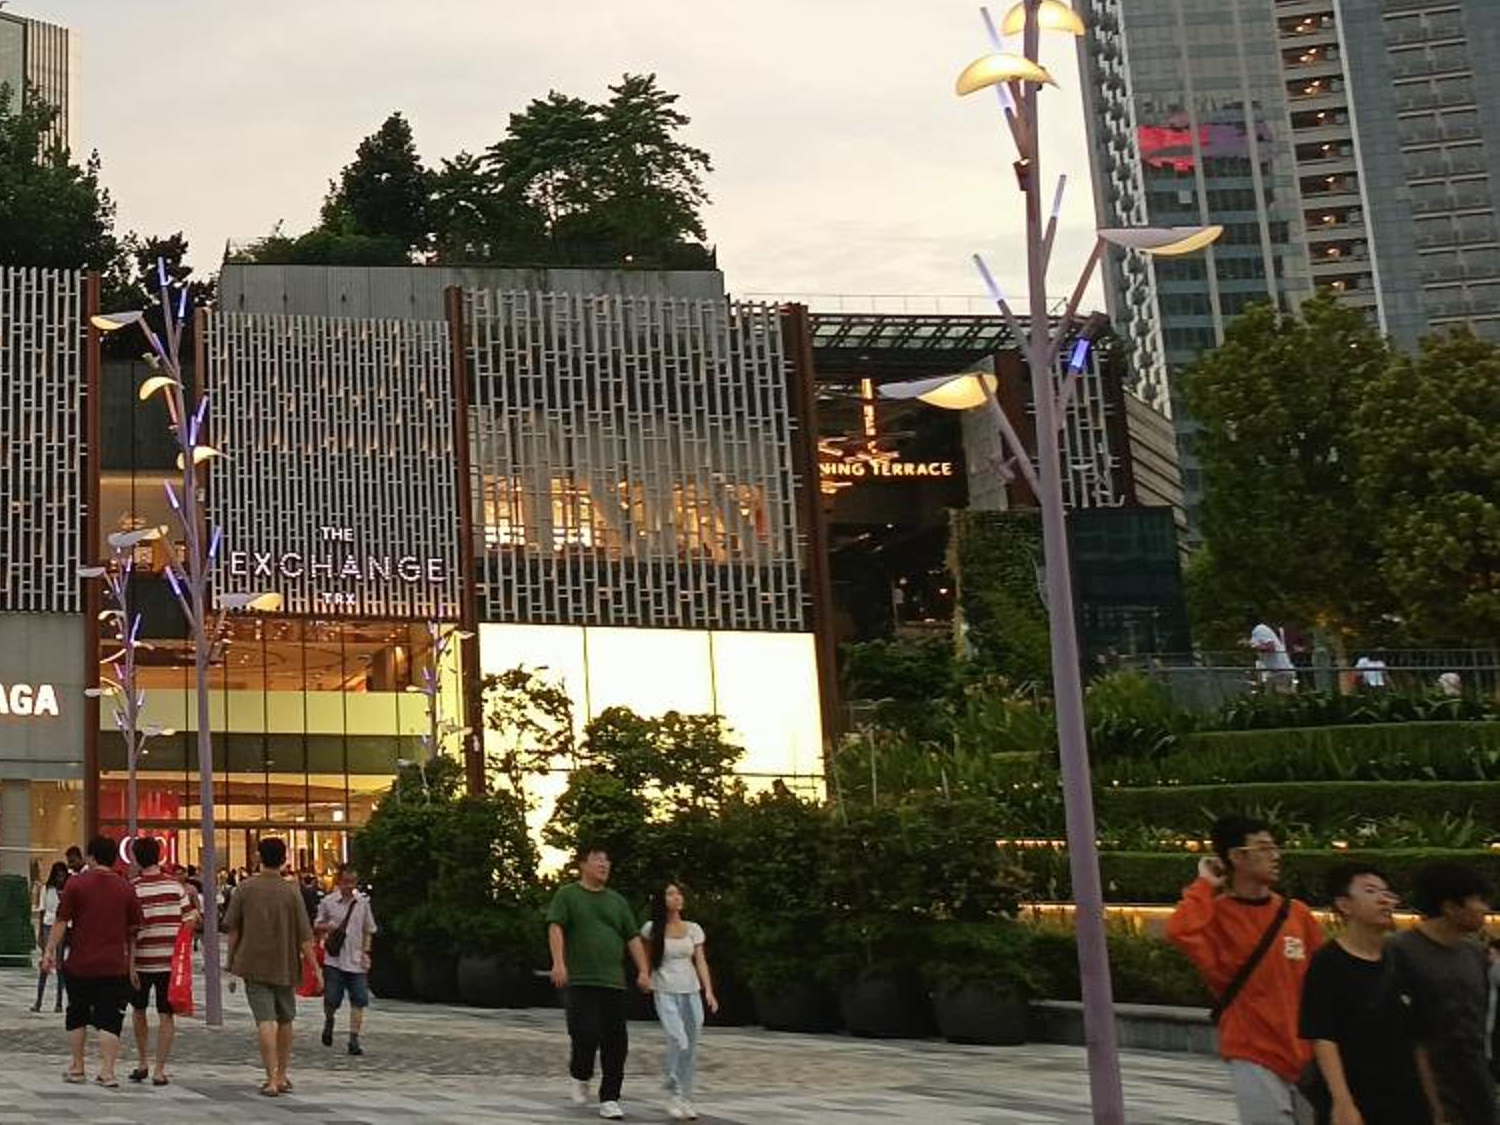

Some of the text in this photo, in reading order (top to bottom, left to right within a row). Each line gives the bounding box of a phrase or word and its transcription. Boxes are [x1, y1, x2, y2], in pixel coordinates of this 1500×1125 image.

[871, 461, 953, 477] TERRACE
[321, 526, 354, 542] THE
[230, 551, 445, 582] EXCHANGE
[322, 592, 356, 606] TRX
